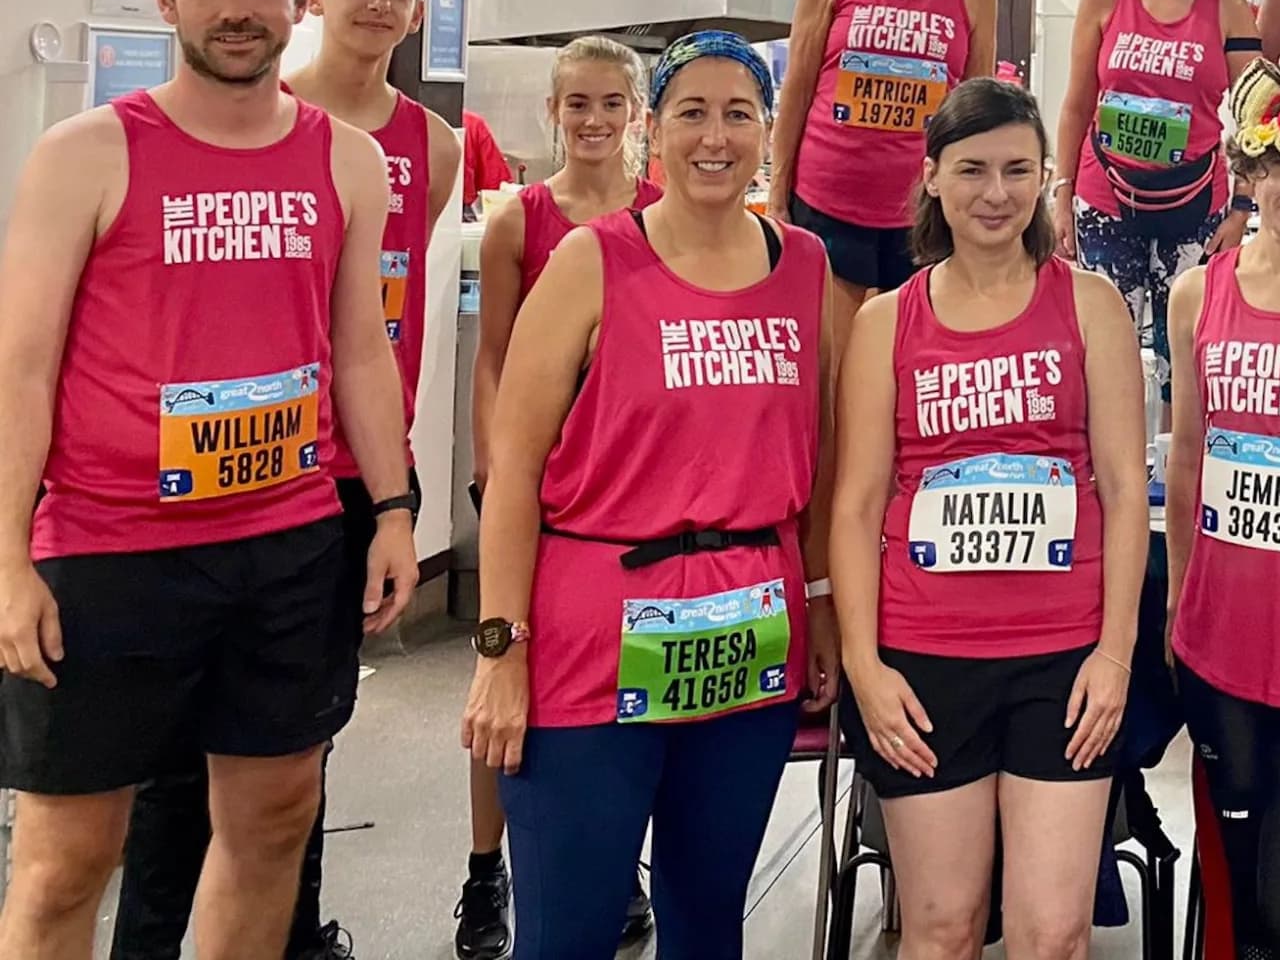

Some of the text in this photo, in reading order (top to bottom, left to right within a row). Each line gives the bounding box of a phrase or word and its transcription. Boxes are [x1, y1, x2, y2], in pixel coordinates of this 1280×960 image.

[847, 24, 927, 54] KITCHEN
[871, 5, 955, 39] PEOPLE'S
[1108, 49, 1176, 77] KITCHEN
[1130, 33, 1205, 62] PEOPLE'S
[853, 77, 928, 105] PATRICIA
[858, 102, 916, 128] 19733
[1117, 113, 1167, 140] ELLENA
[1117, 133, 1163, 159] 55207
[162, 191, 318, 229] THE PEOPLE'S
[164, 225, 281, 265] KITCHEN
[285, 235, 311, 252] 1985
[659, 317, 801, 353] THE PEOPLE'S
[663, 349, 775, 389] KITCHEN
[1205, 341, 1225, 376] THE
[914, 349, 1062, 404] THE PEOPLE'S
[917, 388, 1024, 438] KITCHEN
[1027, 396, 1055, 417] 1985
[191, 404, 302, 453] WILLIAM
[218, 445, 283, 488] 5828
[942, 493, 1046, 526] NATALIA
[950, 530, 1035, 564] 33377
[662, 628, 757, 674] TERESA
[662, 667, 748, 711] 41658
